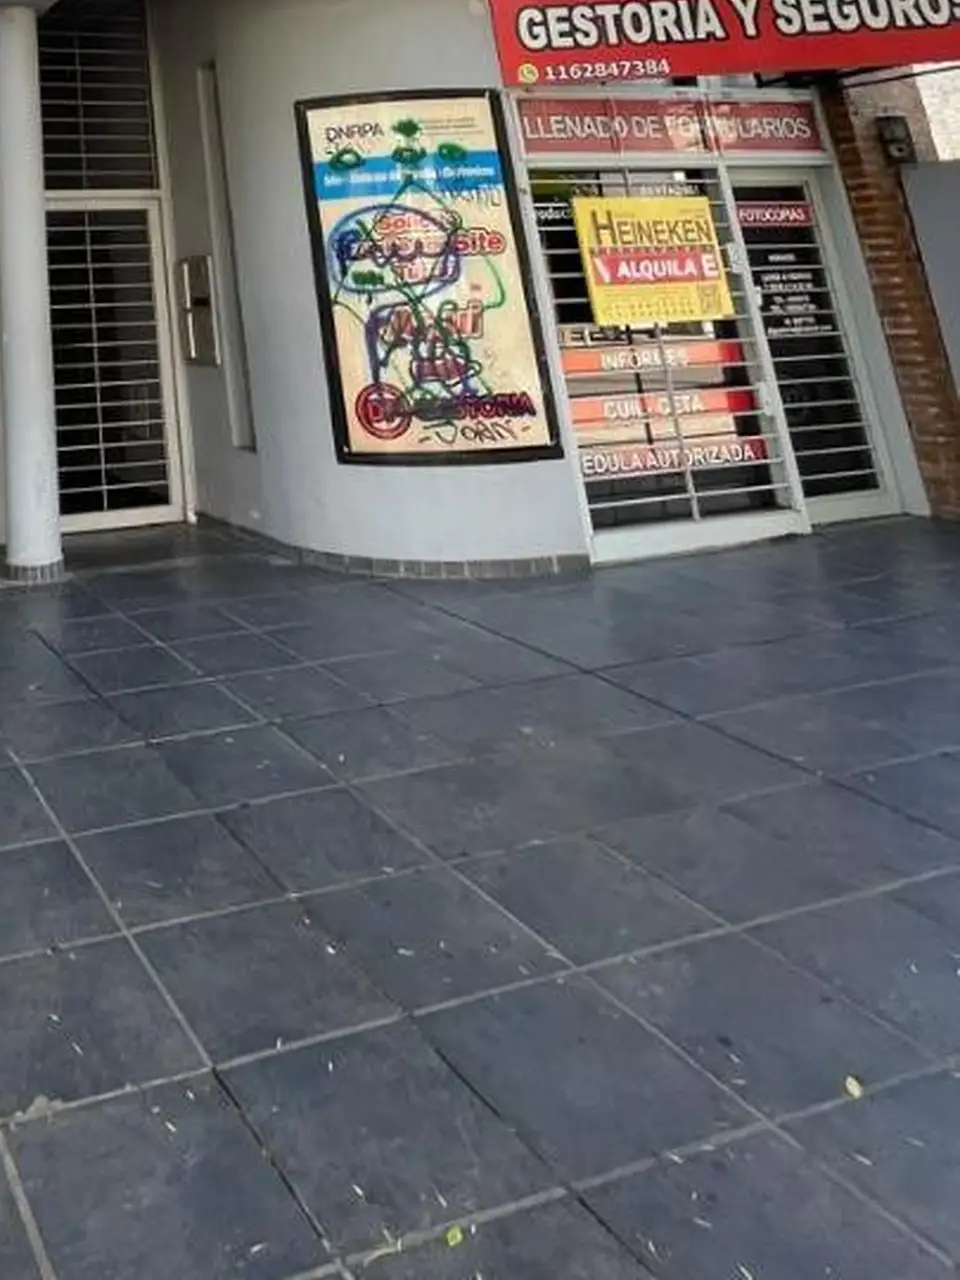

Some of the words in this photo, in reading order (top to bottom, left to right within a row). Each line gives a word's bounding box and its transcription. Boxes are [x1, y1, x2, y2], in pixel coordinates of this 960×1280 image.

[544, 58, 672, 82] 1162847384
[522, 116, 628, 139] LLENADO
[632, 117, 663, 138] DE
[591, 208, 713, 245] HEINEKEN
[739, 207, 806, 222] FOTOCOPIAS
[616, 258, 698, 282] ALQUILA
[581, 451, 644, 475] EDULA
